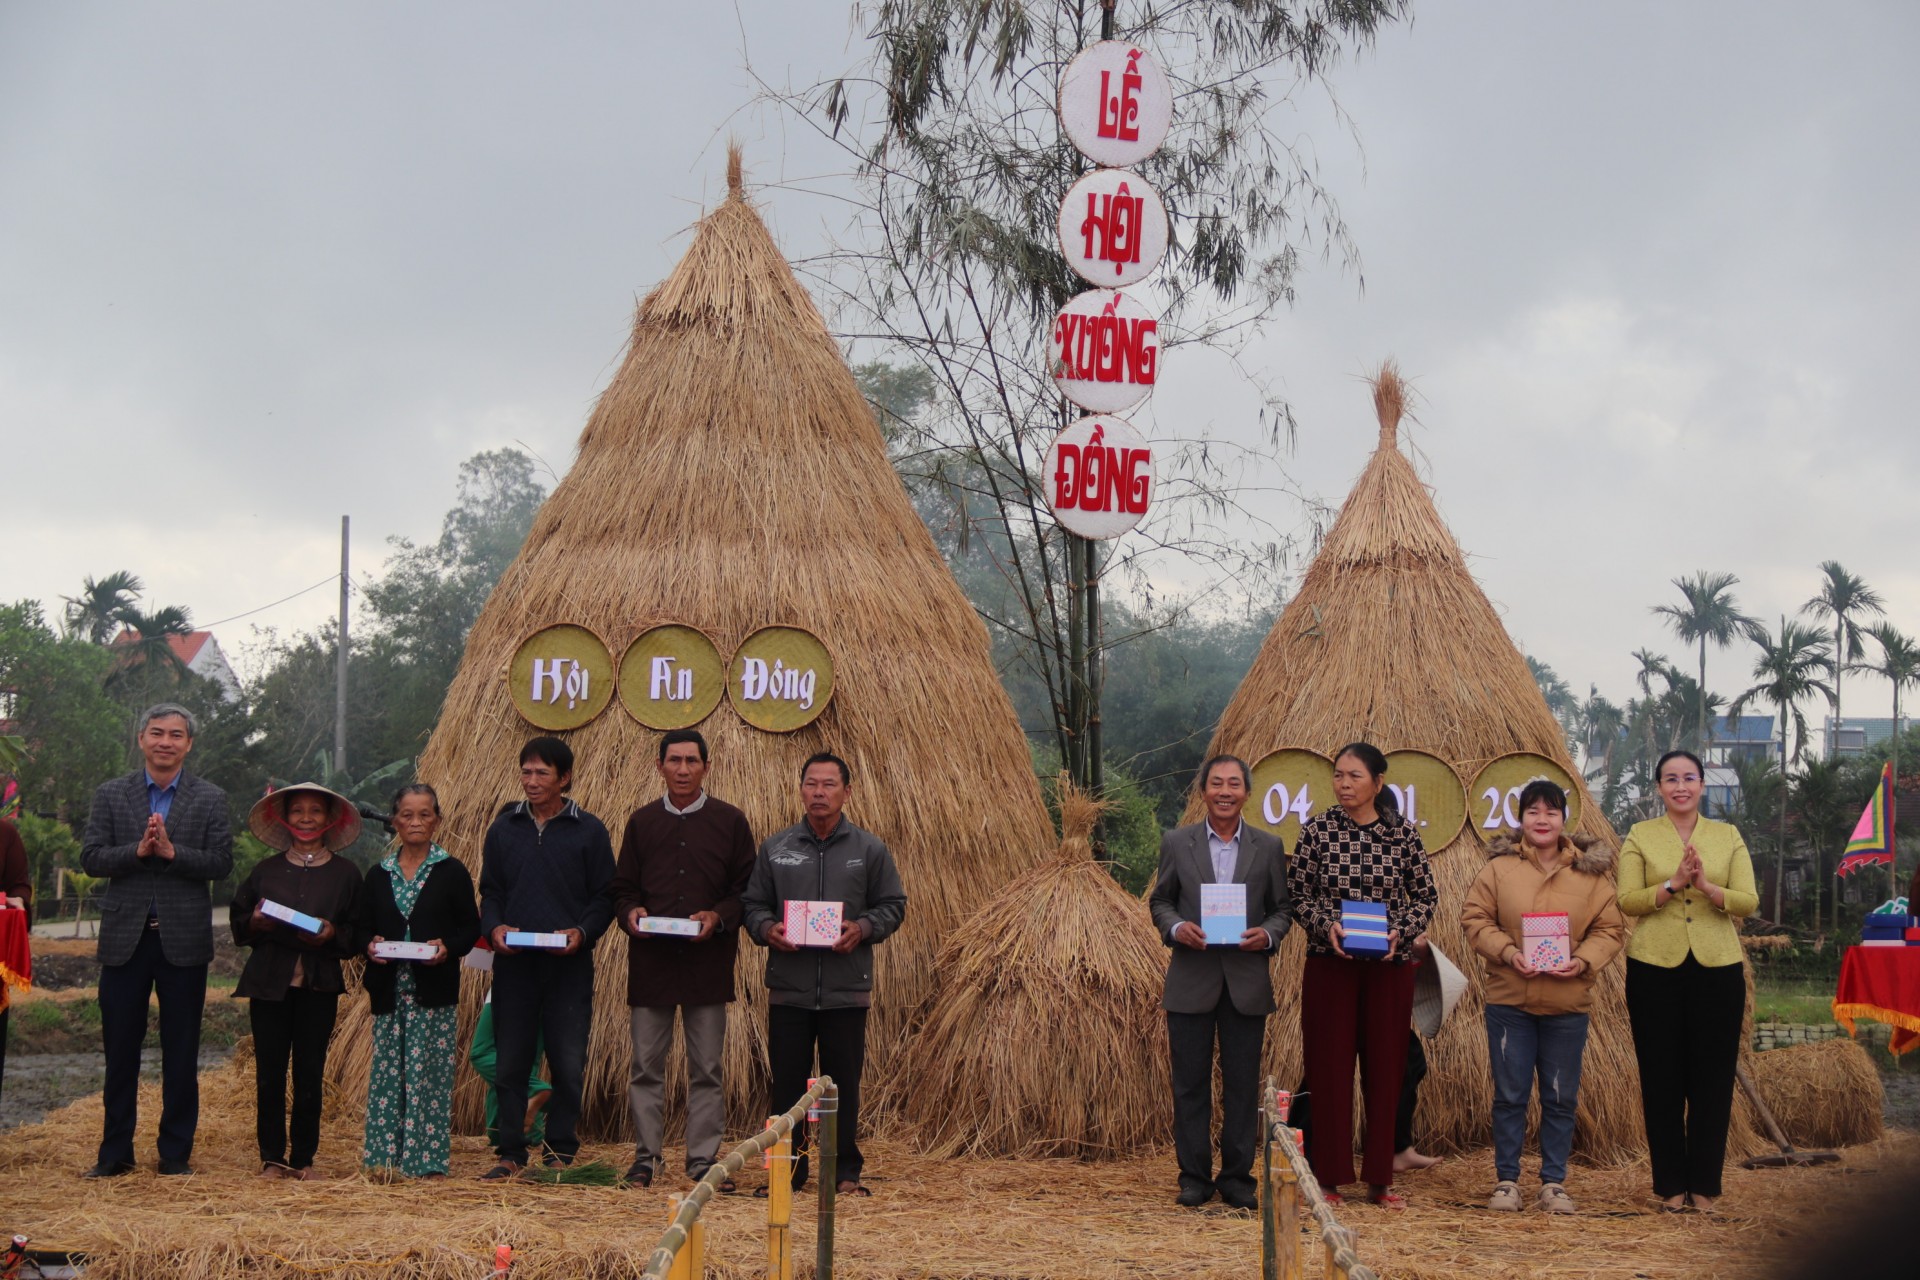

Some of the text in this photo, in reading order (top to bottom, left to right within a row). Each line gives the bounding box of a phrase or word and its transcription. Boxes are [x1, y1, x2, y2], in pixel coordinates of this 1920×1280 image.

[1097, 48, 1143, 141] LỄ
[1080, 181, 1144, 276] HỘI
[1055, 293, 1157, 385] XUỐNG
[1054, 424, 1150, 514] ĐỒNG
[531, 656, 816, 711] Hội An Đông
[1262, 782, 1314, 825] 04
